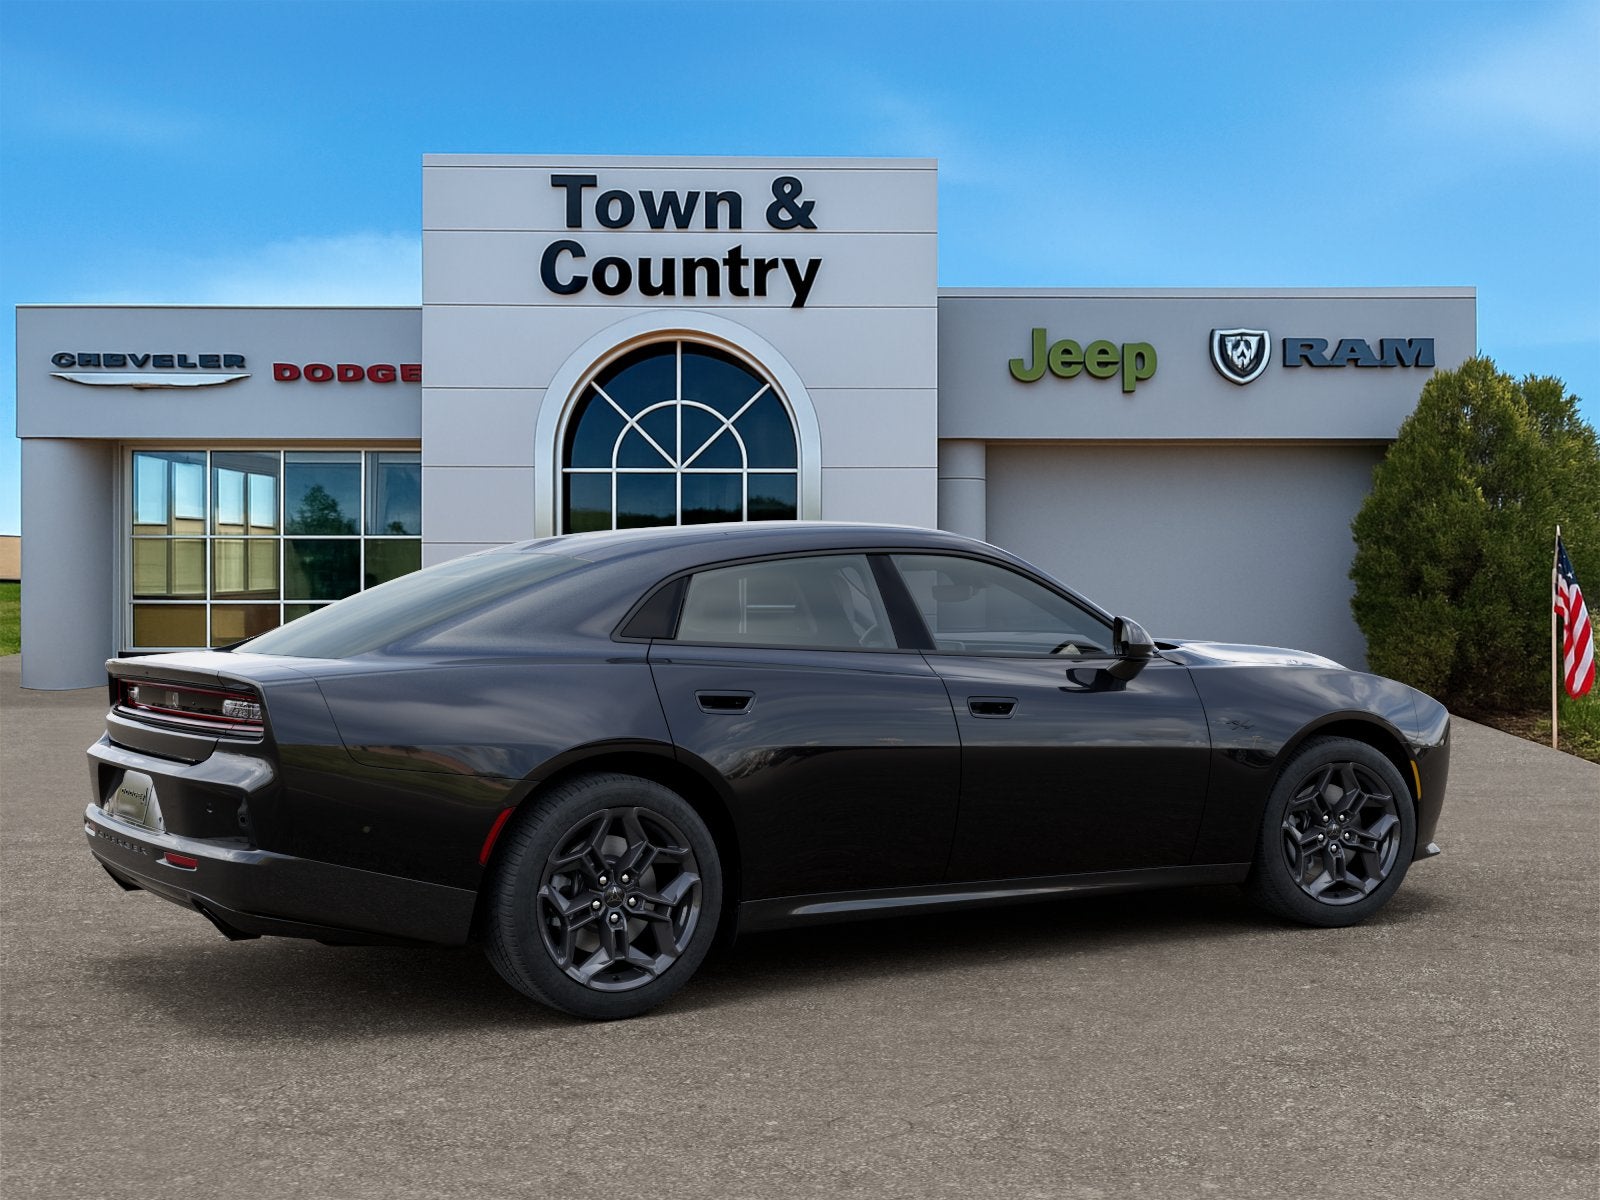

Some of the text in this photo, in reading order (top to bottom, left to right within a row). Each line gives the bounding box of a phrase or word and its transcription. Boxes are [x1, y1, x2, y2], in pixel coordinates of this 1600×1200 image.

[551, 174, 818, 230] Town &
[540, 239, 822, 308] Country
[273, 363, 422, 383] DODGE
[1009, 327, 1158, 393] Jeep
[1282, 337, 1436, 368] RAM
